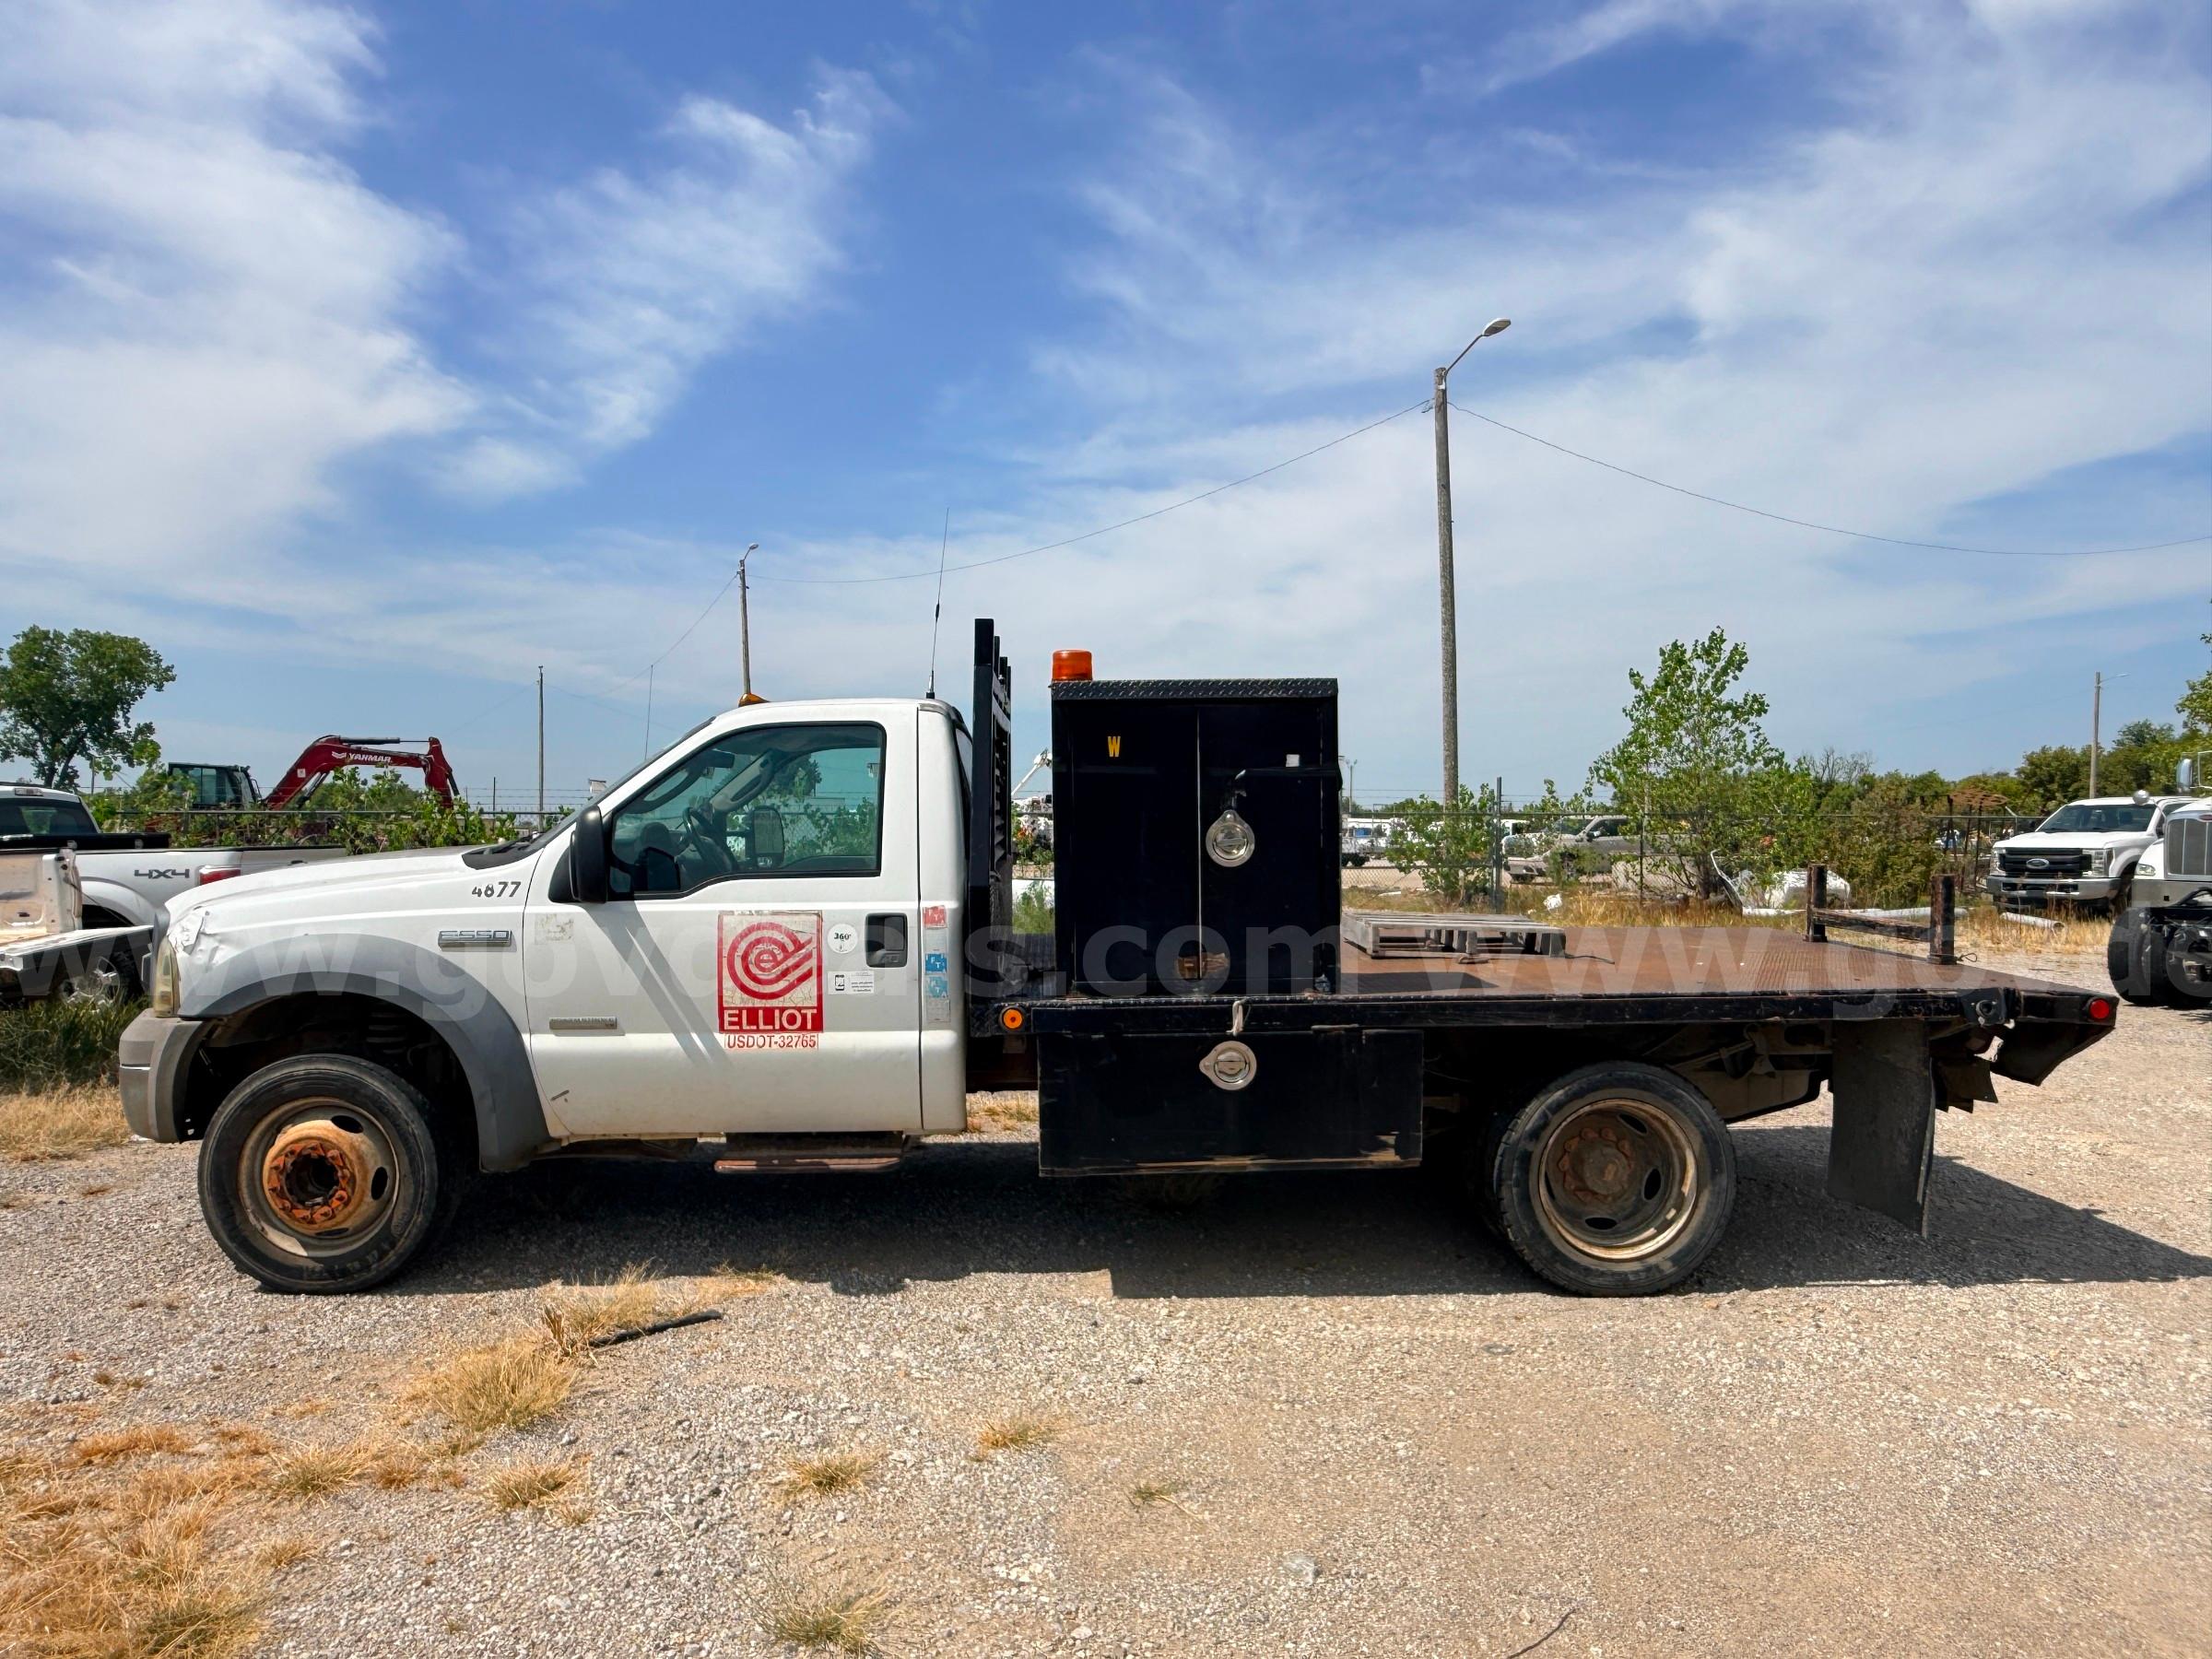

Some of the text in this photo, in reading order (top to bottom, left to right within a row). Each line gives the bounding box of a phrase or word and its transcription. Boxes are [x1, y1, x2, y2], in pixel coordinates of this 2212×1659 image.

[1107, 735, 1122, 758] W
[348, 752, 392, 763] YANMAR
[471, 881, 522, 898] 4877
[724, 1008, 818, 1030] ELLIOT
